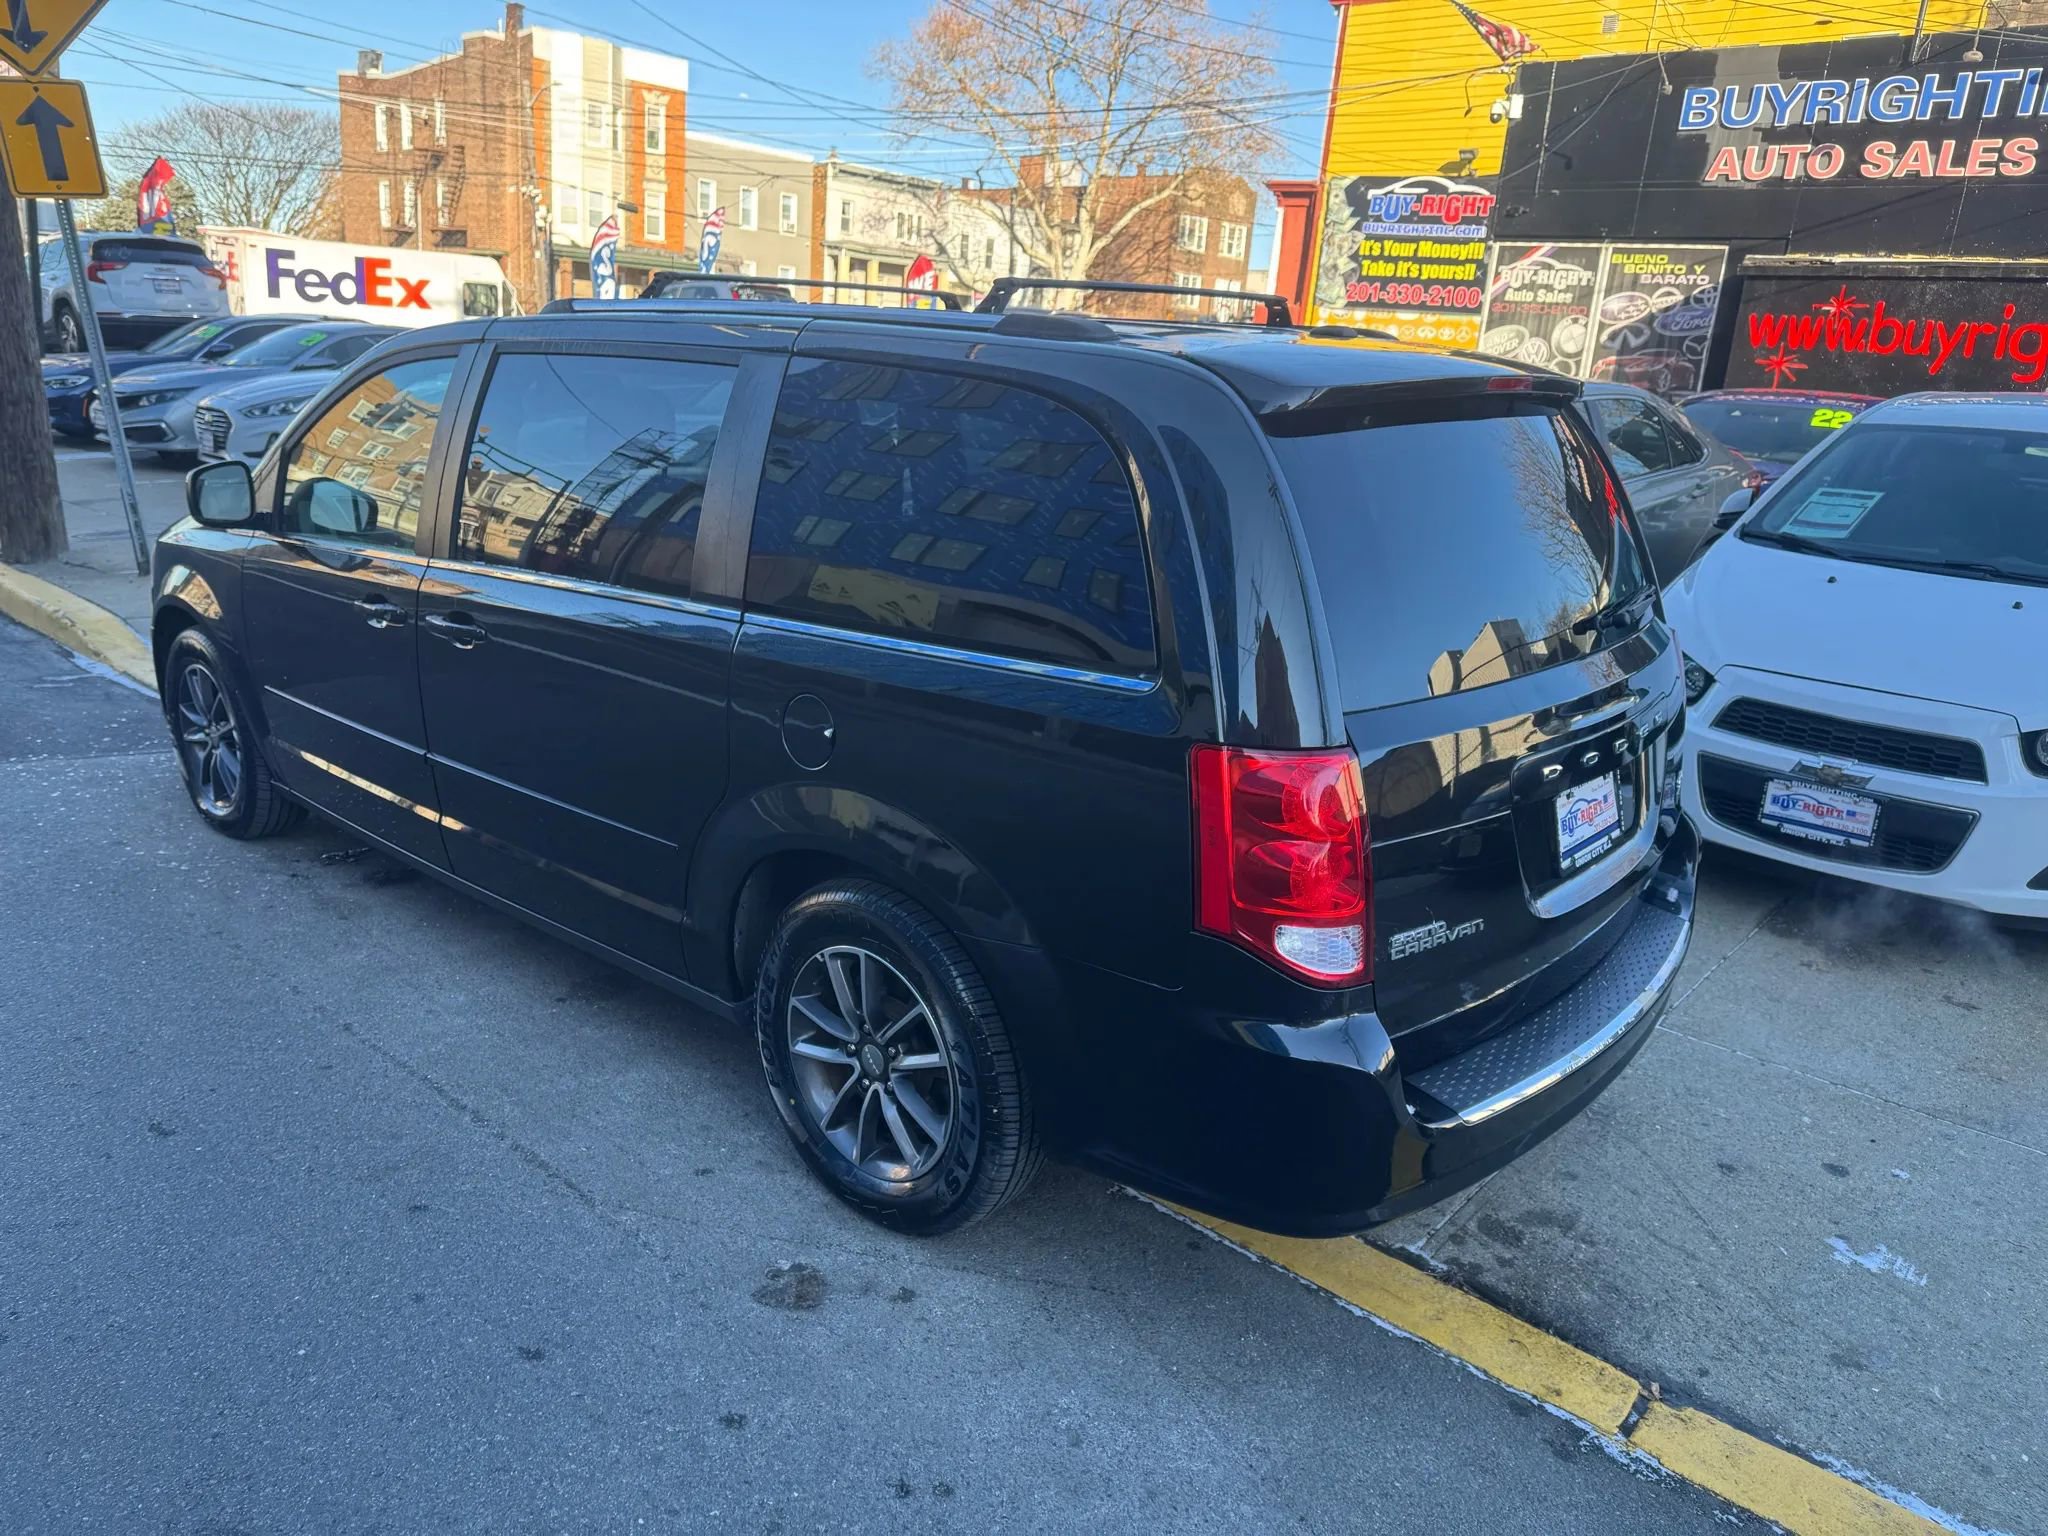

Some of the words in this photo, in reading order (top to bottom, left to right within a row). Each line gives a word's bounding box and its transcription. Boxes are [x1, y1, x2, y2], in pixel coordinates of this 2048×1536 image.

[1678, 66, 2048, 132] BUYRIGHTI
[1704, 144, 1845, 182] AUTO
[1860, 137, 2039, 178] SALES
[1368, 194, 1497, 225] BUY-RIGHT
[1359, 239, 1382, 256] It's
[1383, 240, 1416, 257] Your
[1417, 241, 1486, 261] Money!!!
[1611, 253, 1669, 265] BUENO
[265, 247, 432, 310] FedEx
[1361, 259, 1396, 277] Take
[1419, 263, 1478, 281] yours!!
[1623, 263, 1687, 275] BONITO
[1692, 264, 1706, 276] Y
[1639, 273, 1711, 286] BARATO
[1345, 281, 1482, 308] 201-330-2100
[1504, 288, 1535, 303] Auto
[1536, 288, 1574, 304] Sales
[1671, 311, 1713, 331] Ford
[1810, 408, 1853, 429] 22
[1779, 826, 1806, 839] UNION
[1391, 918, 1485, 961] CARAVAN
